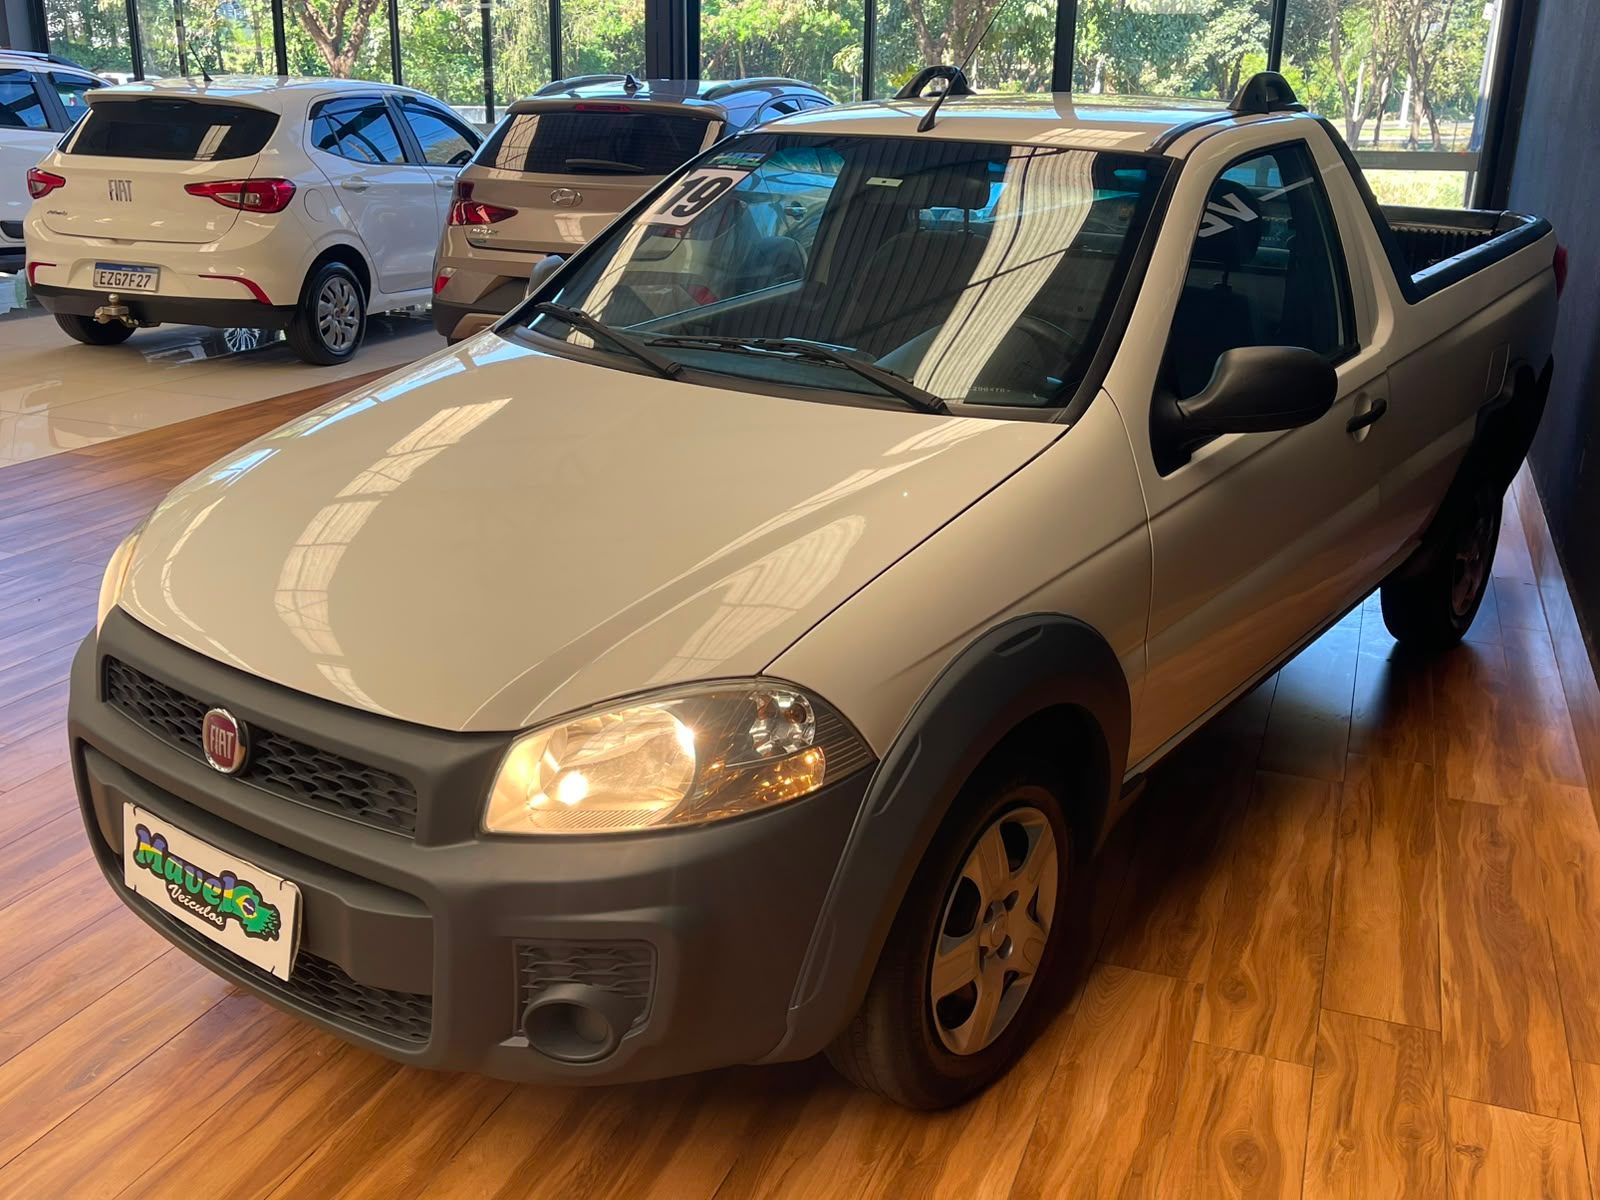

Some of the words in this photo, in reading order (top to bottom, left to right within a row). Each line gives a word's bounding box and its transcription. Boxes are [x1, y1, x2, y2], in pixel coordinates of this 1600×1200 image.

[108, 179, 132, 202] FIAT
[654, 176, 733, 217] 19
[99, 271, 152, 288] EZG7F27
[210, 724, 234, 760] FIAT
